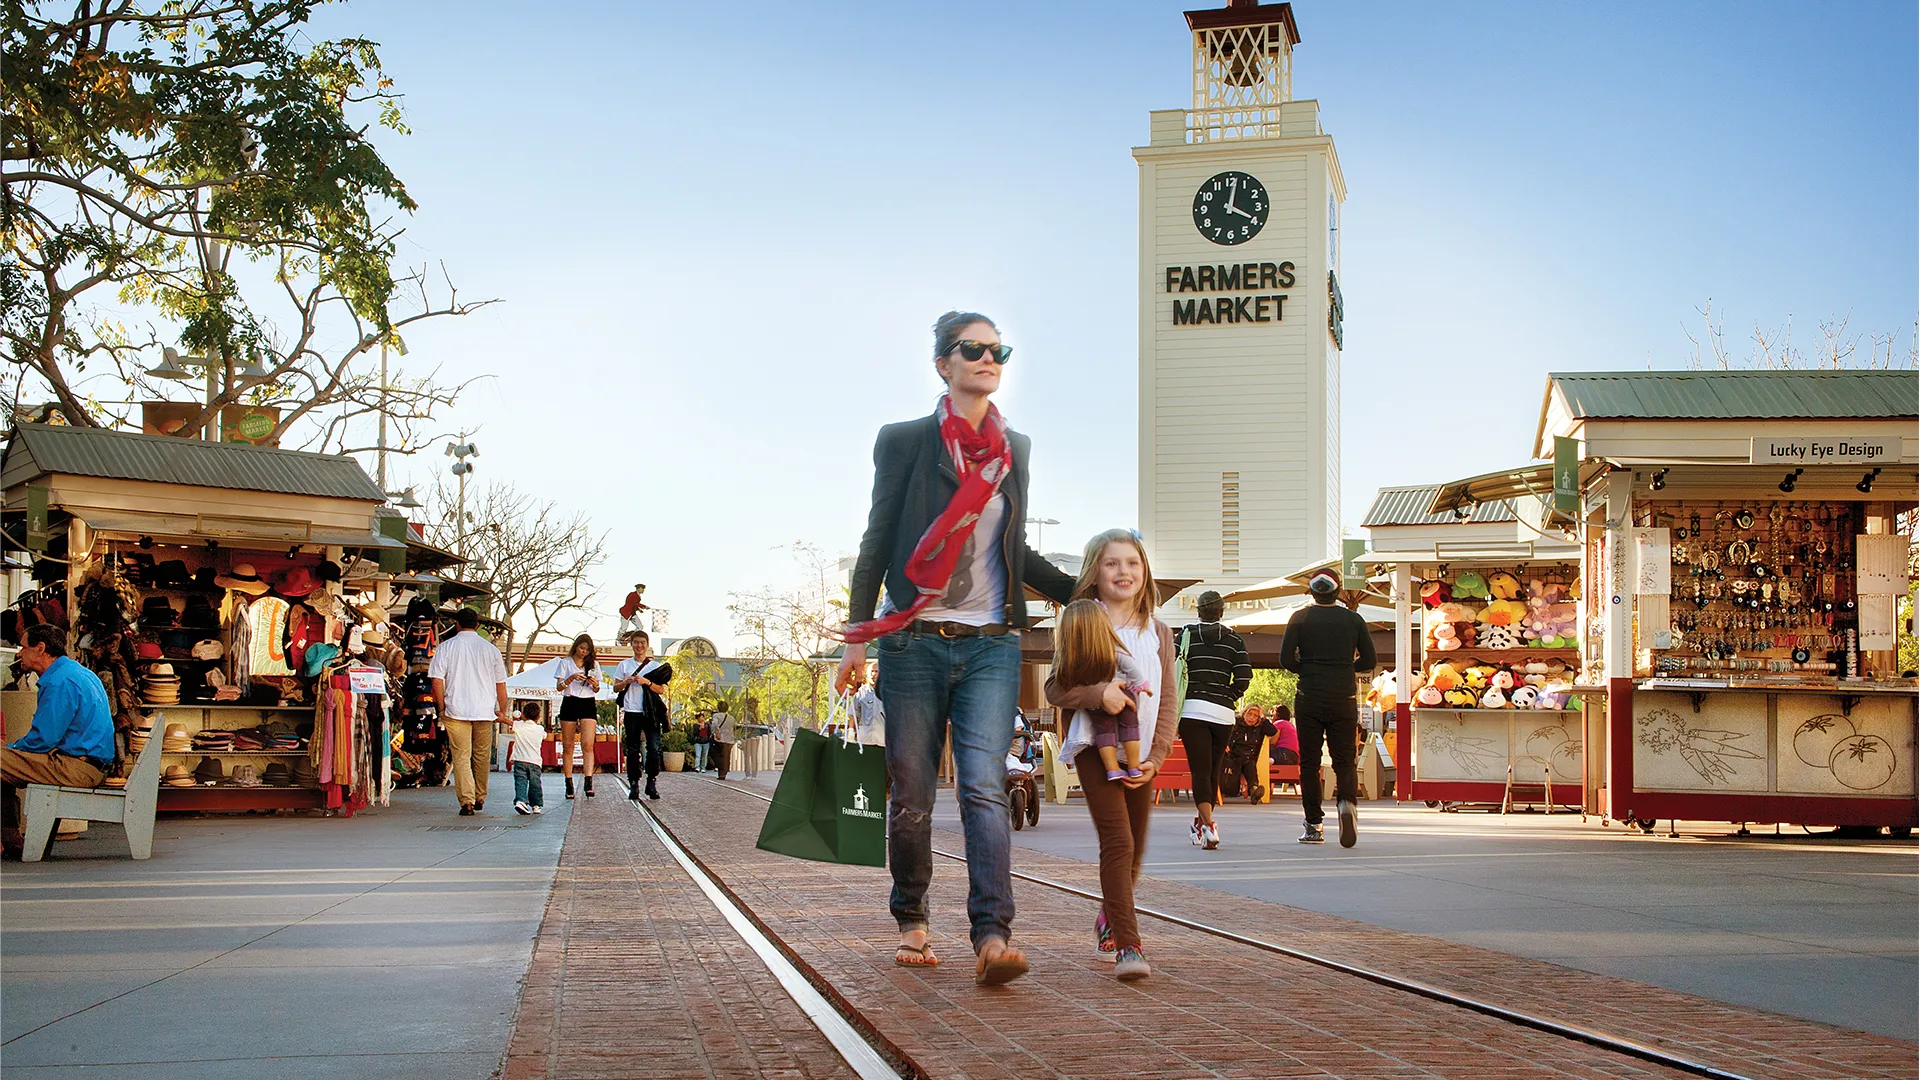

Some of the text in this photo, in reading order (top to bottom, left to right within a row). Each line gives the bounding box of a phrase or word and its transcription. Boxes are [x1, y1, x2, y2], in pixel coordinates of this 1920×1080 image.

[1214, 181, 1222, 191] 11
[1225, 177, 1237, 187] 12
[1202, 192, 1213, 202] 10
[1251, 189, 1259, 199] 2
[1200, 205, 1208, 215] 9
[1254, 202, 1262, 212] 3
[1203, 218, 1211, 228] 8
[1250, 216, 1258, 226] 4
[1214, 227, 1222, 237] 7
[1226, 230, 1235, 240] 6
[1241, 225, 1249, 235] 5
[1166, 261, 1296, 293] FARMERS
[1172, 294, 1288, 325] MARKET
[1770, 442, 1883, 459] Lucky Eye Design
[545, 645, 613, 655] GILRE
[842, 806, 863, 817] FARMERS
